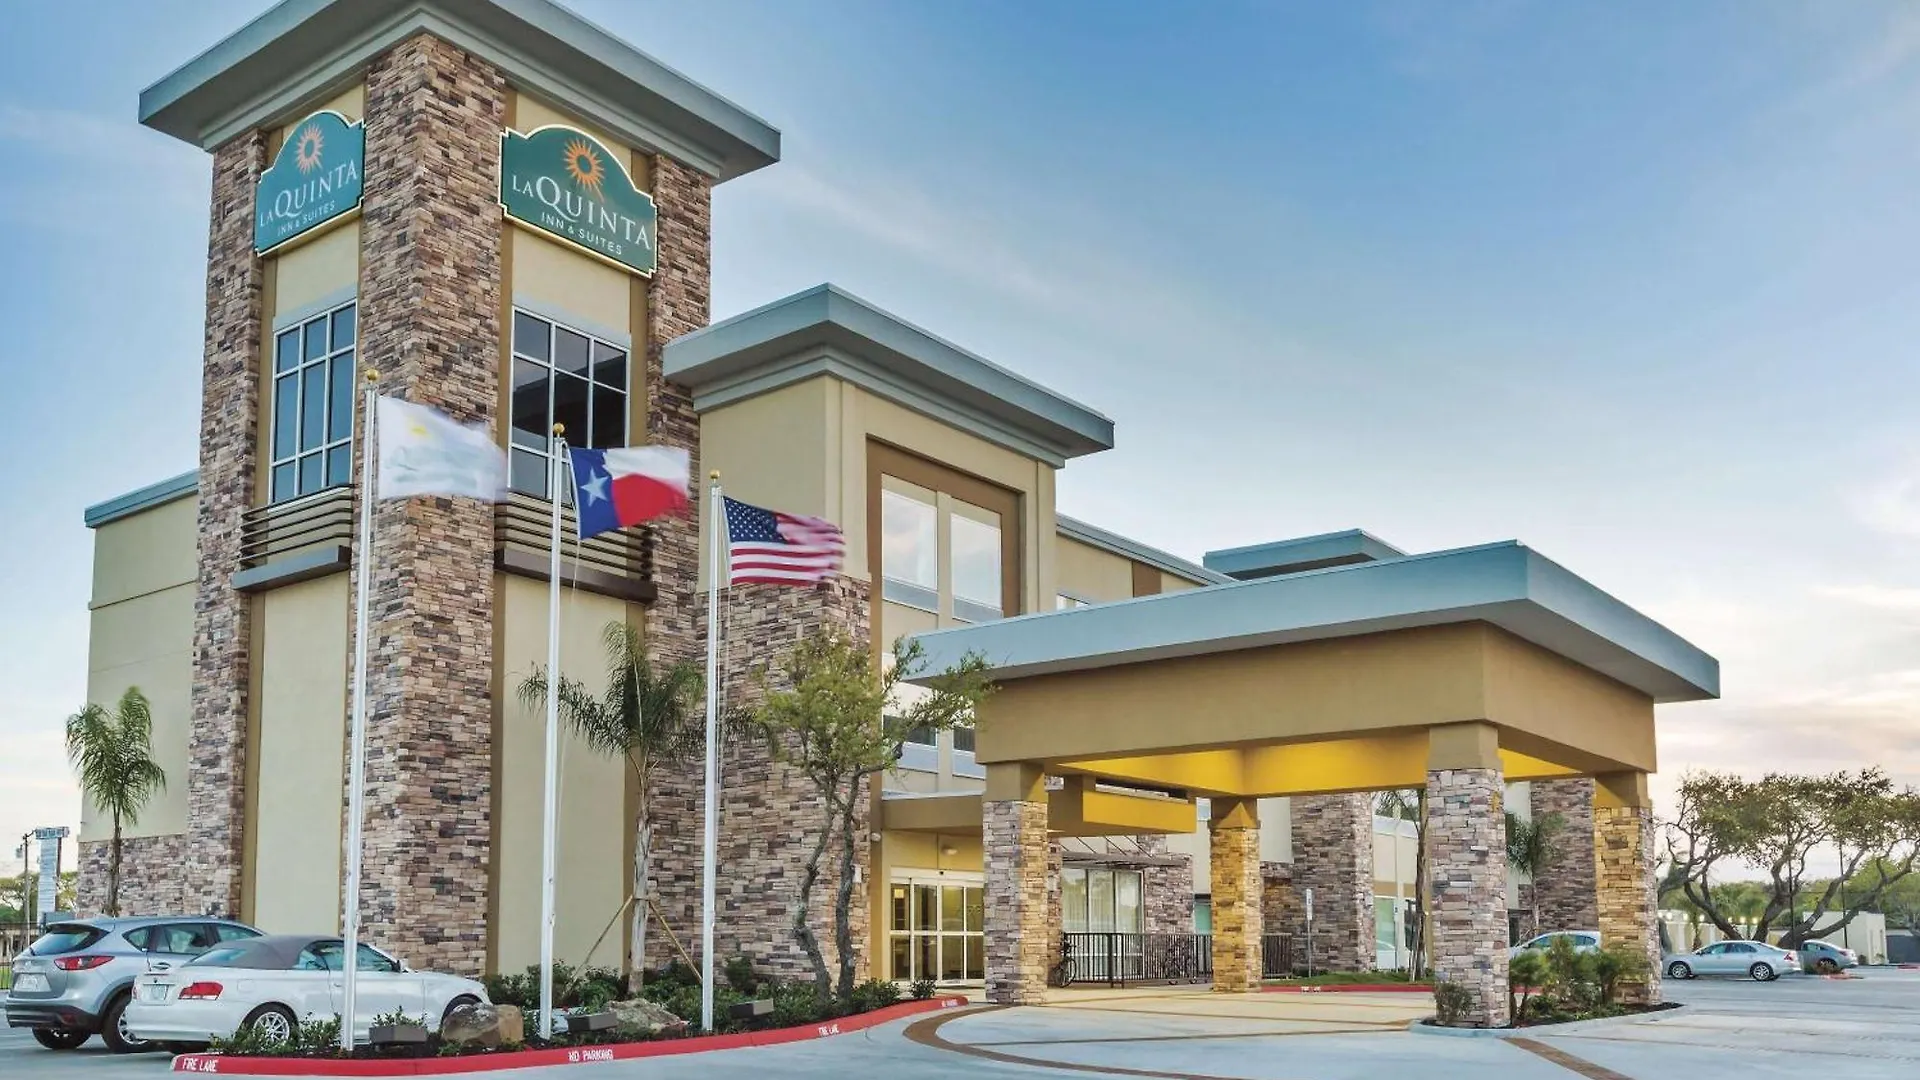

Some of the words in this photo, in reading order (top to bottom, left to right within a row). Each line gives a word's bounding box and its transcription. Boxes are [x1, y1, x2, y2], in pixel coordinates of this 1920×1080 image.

[260, 211, 274, 227] LA
[275, 159, 358, 218] QUINTA
[512, 175, 535, 198] LA
[536, 176, 651, 250] QUINTA
[277, 223, 293, 236] INN
[302, 200, 336, 224] SUITES
[541, 211, 564, 229] INN
[567, 226, 575, 235] &
[579, 228, 622, 256] SUITES
[182, 1057, 198, 1071] FIRE
[199, 1059, 219, 1072] LANE
[568, 1050, 580, 1062] NO
[582, 1048, 614, 1061] PARKING
